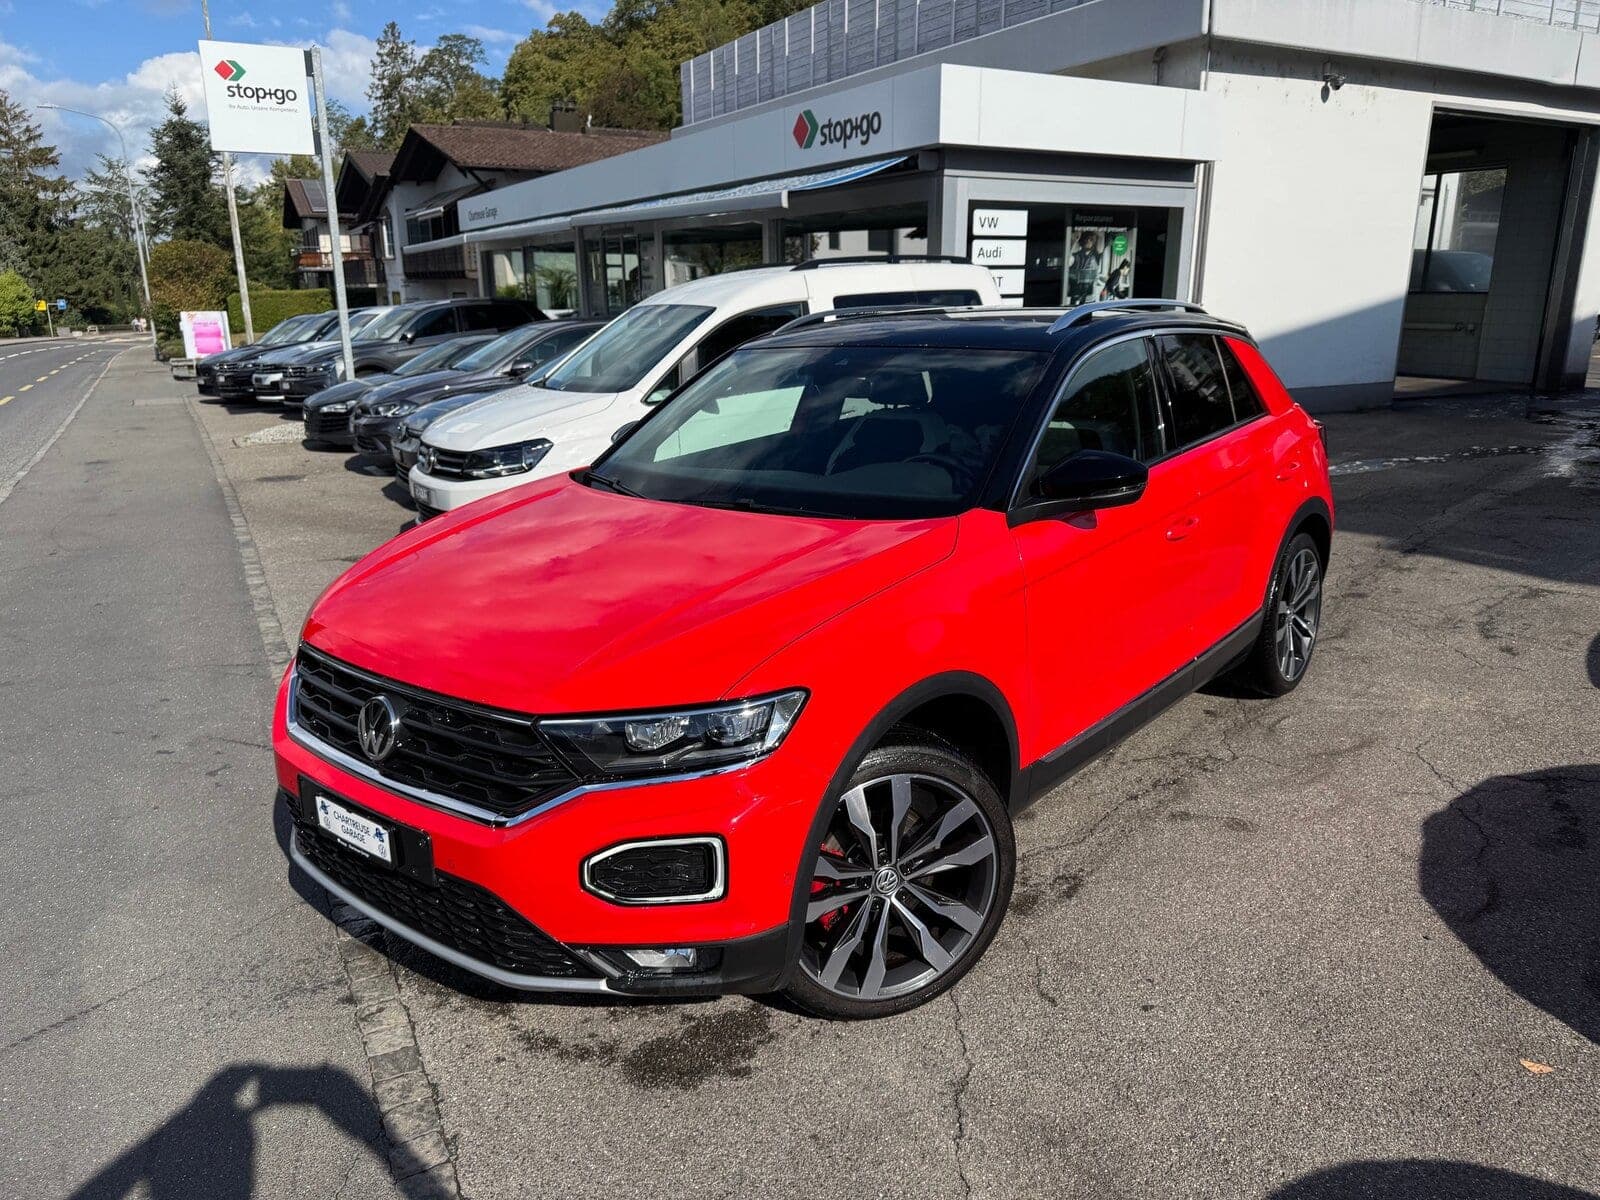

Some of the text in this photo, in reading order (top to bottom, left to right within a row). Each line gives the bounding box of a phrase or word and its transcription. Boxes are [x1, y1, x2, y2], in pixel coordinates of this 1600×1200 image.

[978, 216, 1000, 229] VW
[976, 246, 1002, 260] Audi
[333, 810, 371, 837] CHARTREUSE
[341, 824, 367, 844] GARAGE
